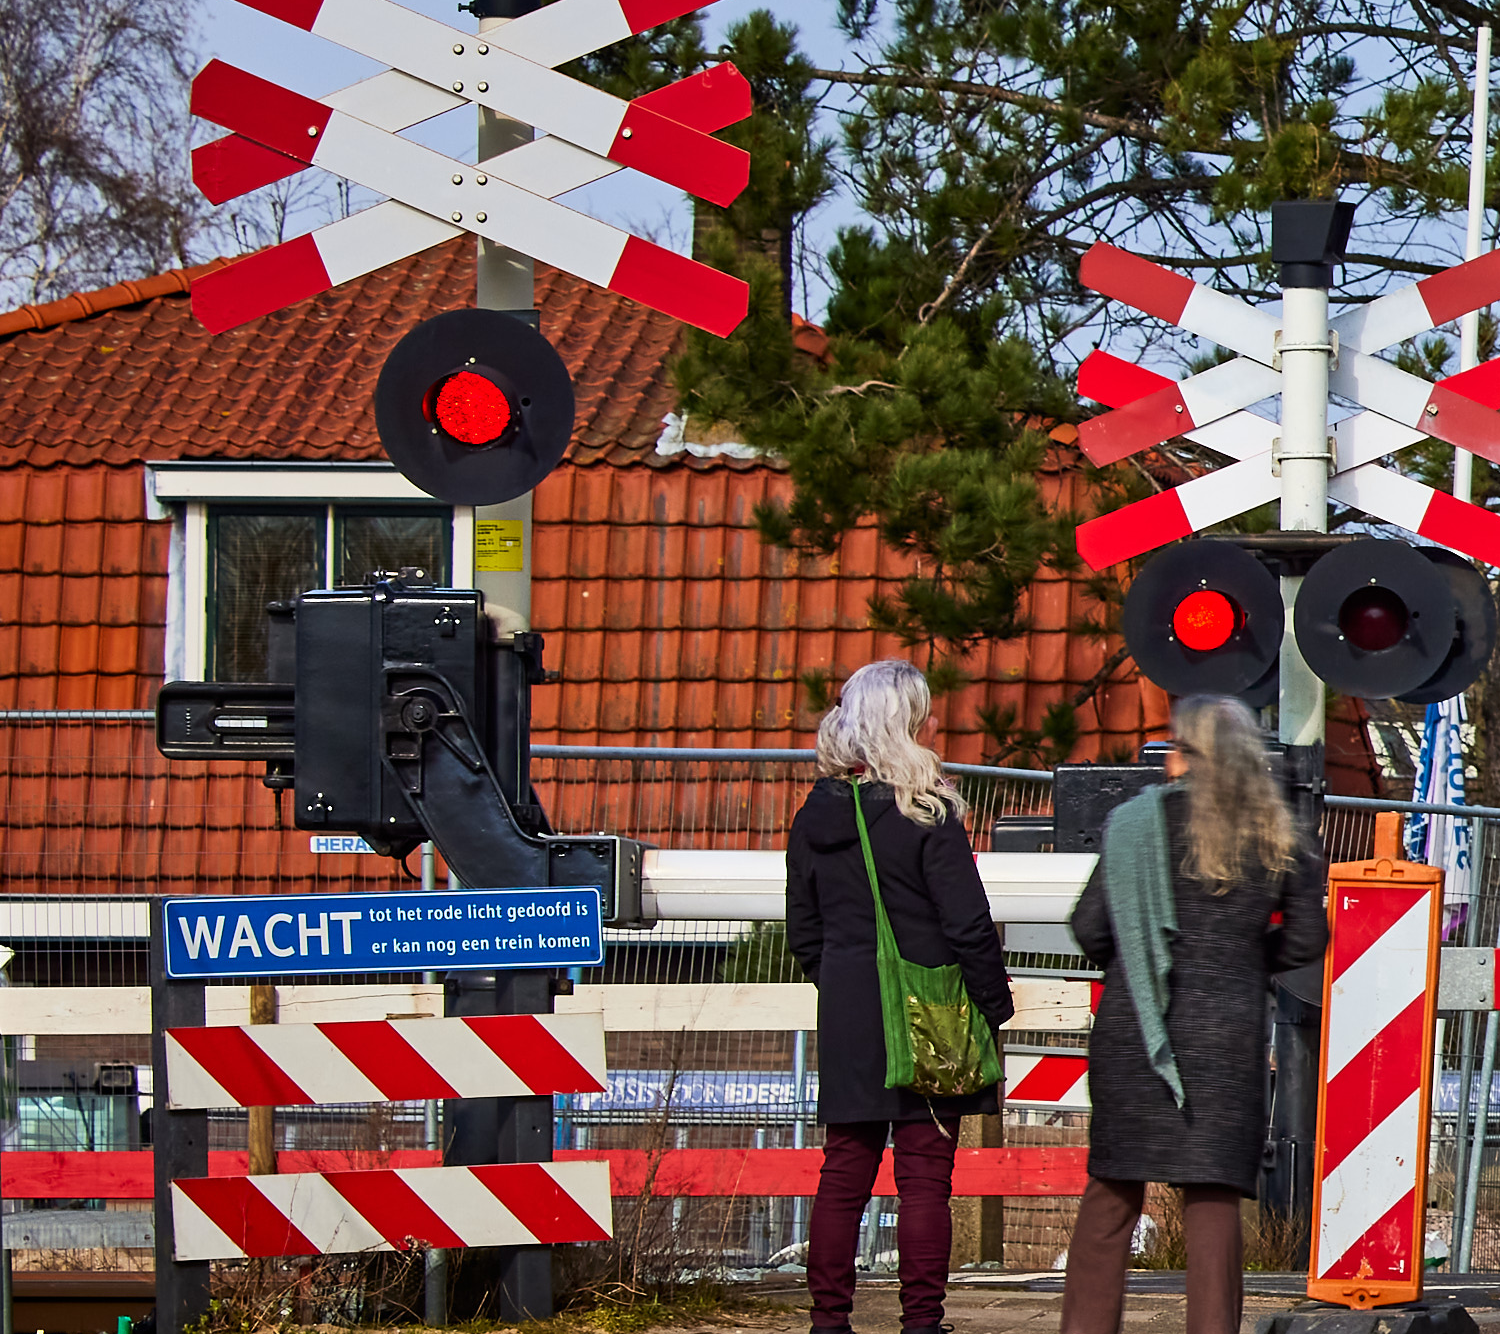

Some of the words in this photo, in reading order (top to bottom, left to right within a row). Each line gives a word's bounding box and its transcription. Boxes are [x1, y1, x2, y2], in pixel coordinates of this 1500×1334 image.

[316, 838, 374, 852] HERA
[369, 908, 392, 922] tot
[397, 906, 422, 921] het
[427, 904, 462, 920] rode
[467, 902, 502, 919] licht
[507, 901, 571, 923] gedoofd
[576, 901, 588, 916] is
[179, 911, 361, 959] WACHT
[371, 942, 388, 954] er
[393, 938, 420, 953] kan
[426, 940, 456, 956] nog
[461, 939, 490, 951] een
[495, 935, 533, 950] trein
[538, 933, 590, 949] komen
[602, 1081, 655, 1104] BASIS
[724, 1082, 795, 1104] IEDERE
